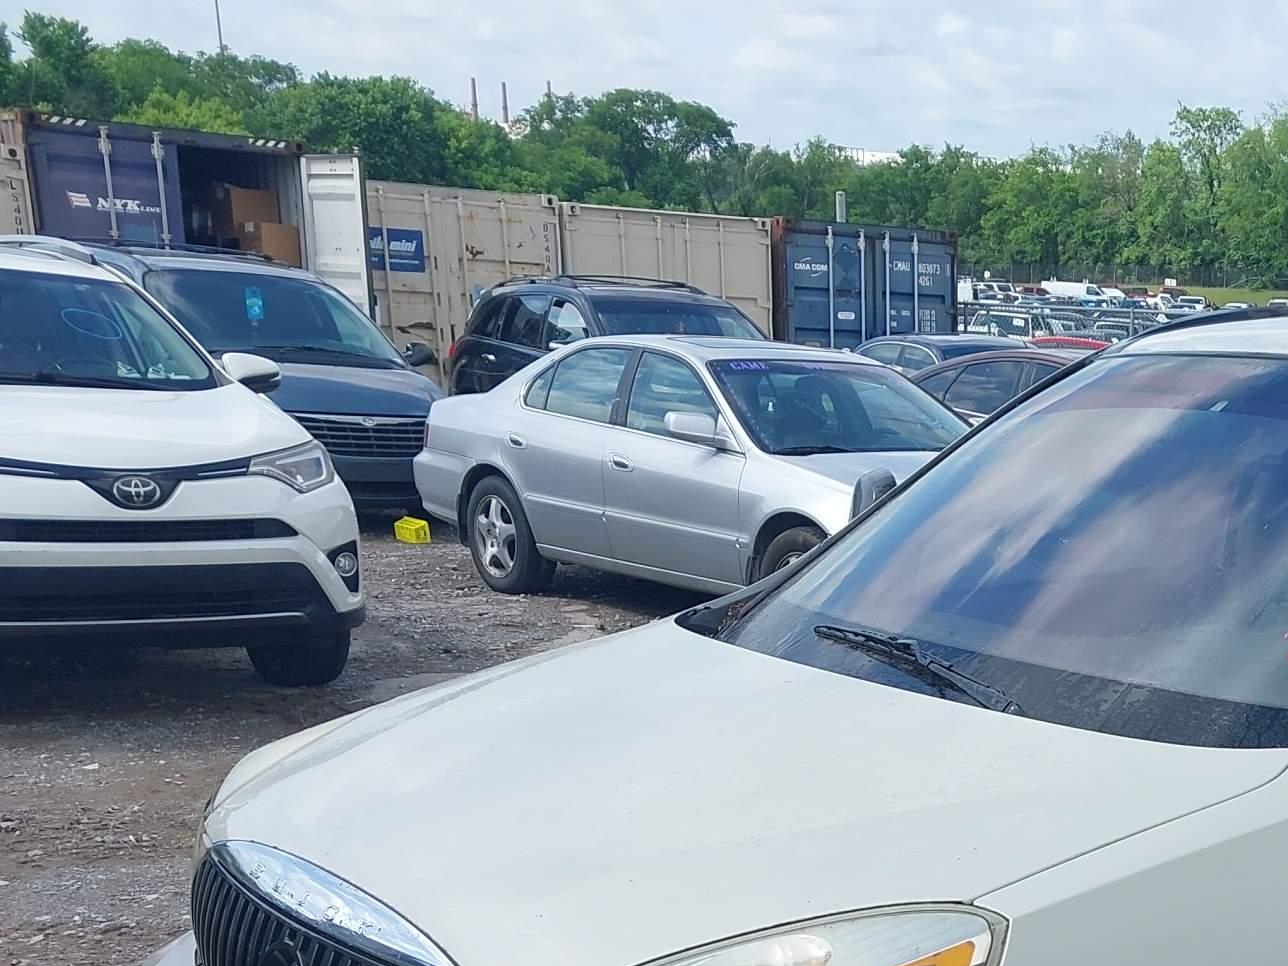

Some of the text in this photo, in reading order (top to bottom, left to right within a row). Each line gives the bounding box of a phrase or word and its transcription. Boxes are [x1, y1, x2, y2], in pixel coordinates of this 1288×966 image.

[97, 196, 141, 212] NYK
[389, 240, 417, 252] mini
[794, 262, 828, 272] CMA CGM
